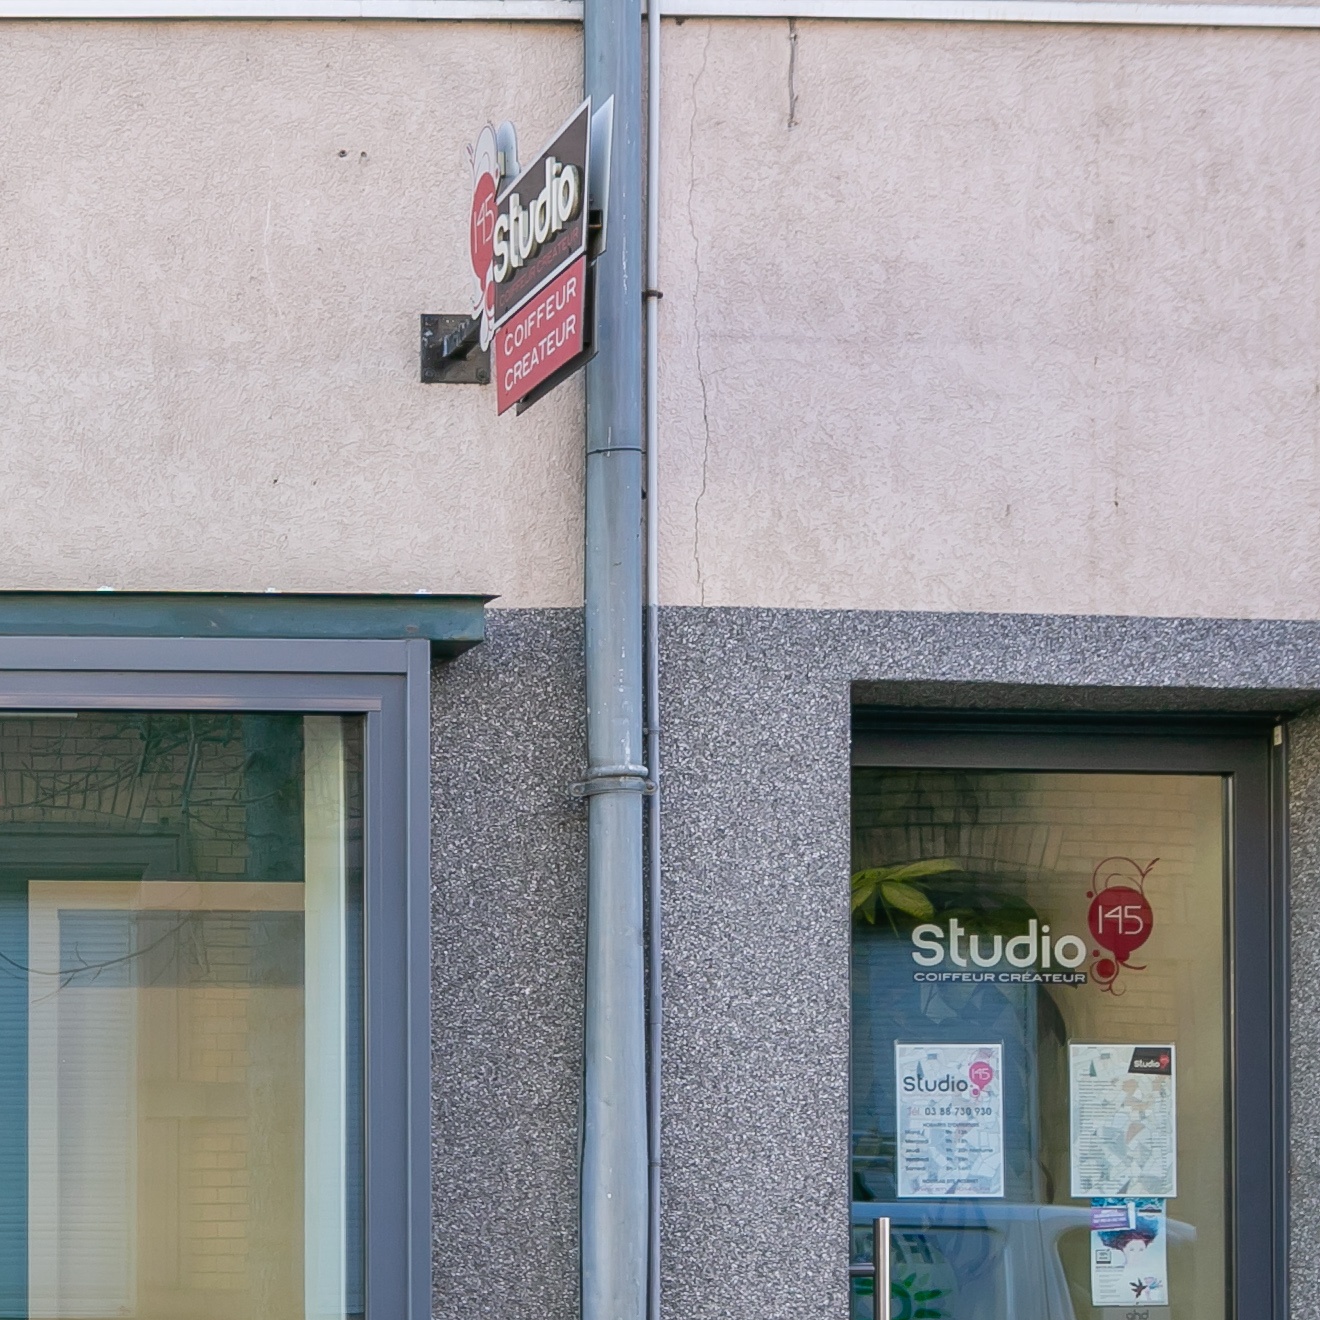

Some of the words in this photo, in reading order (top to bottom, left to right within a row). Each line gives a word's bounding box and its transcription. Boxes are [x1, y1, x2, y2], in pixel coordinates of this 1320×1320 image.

[473, 192, 496, 255] 145
[493, 156, 580, 284] Studio
[503, 276, 577, 357] COIFFEUR
[503, 314, 577, 392] CREATEUR
[1098, 905, 1144, 935] 145
[911, 918, 1087, 969] Studio
[913, 972, 996, 982] COIFFEUR
[998, 970, 1086, 983] CRÉATEUR
[903, 1074, 969, 1092] Studio
[1134, 1059, 1160, 1068] Studio
[924, 1107, 937, 1116] 03
[974, 1107, 992, 1116] 930
